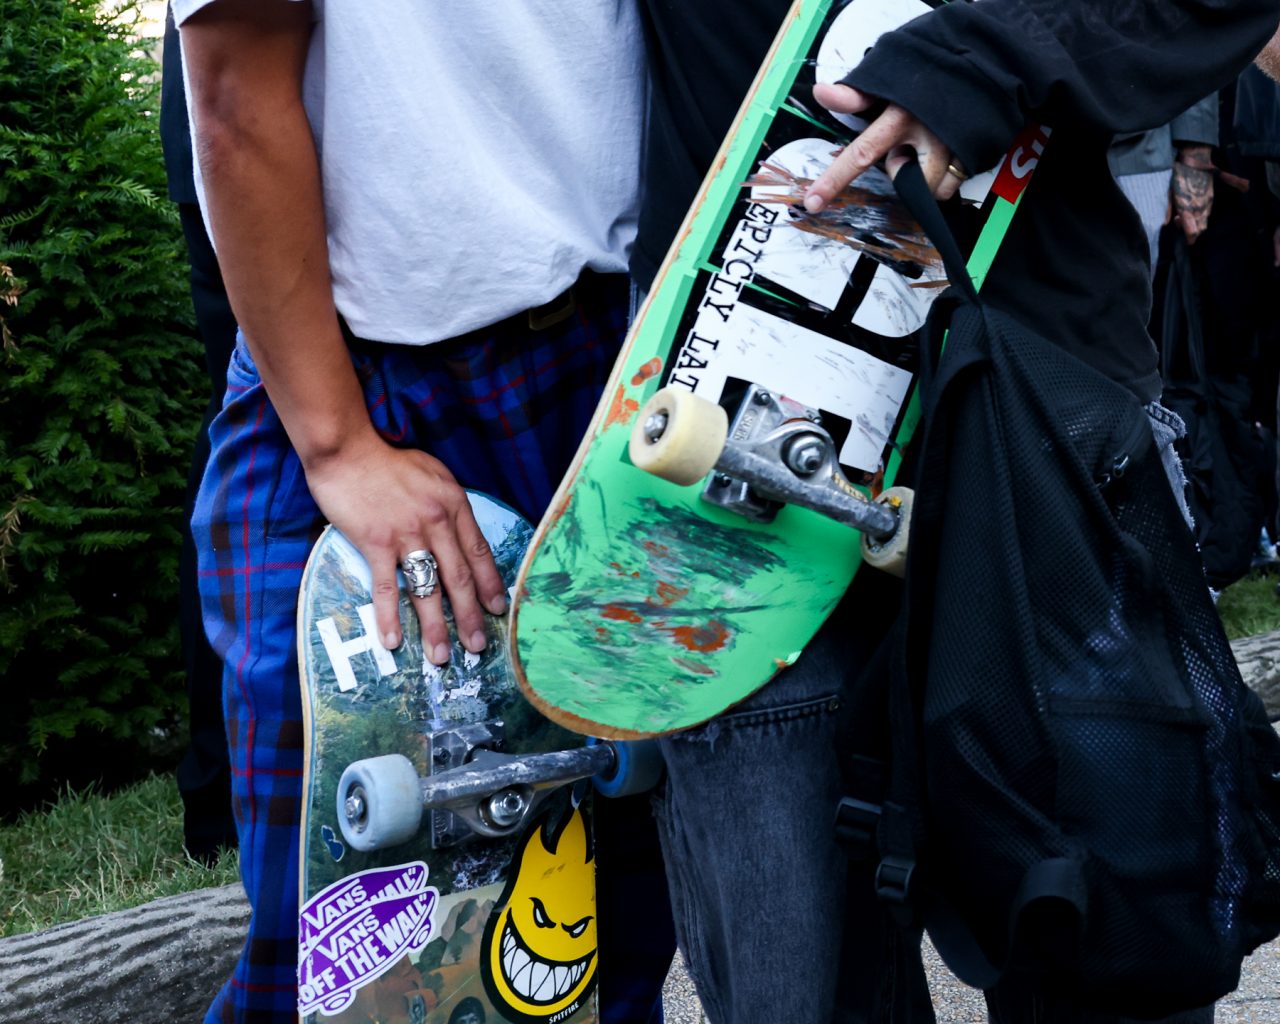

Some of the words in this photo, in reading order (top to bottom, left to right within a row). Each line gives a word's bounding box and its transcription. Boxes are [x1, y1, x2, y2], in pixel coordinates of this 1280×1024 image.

[704, 203, 779, 322] EPICLY
[670, 331, 719, 392] LAT
[302, 878, 367, 930] VANS
[316, 908, 379, 961] VANS
[300, 967, 336, 1004] OFF
[334, 935, 386, 981] THE
[549, 1001, 580, 1024] SPITFIRE
